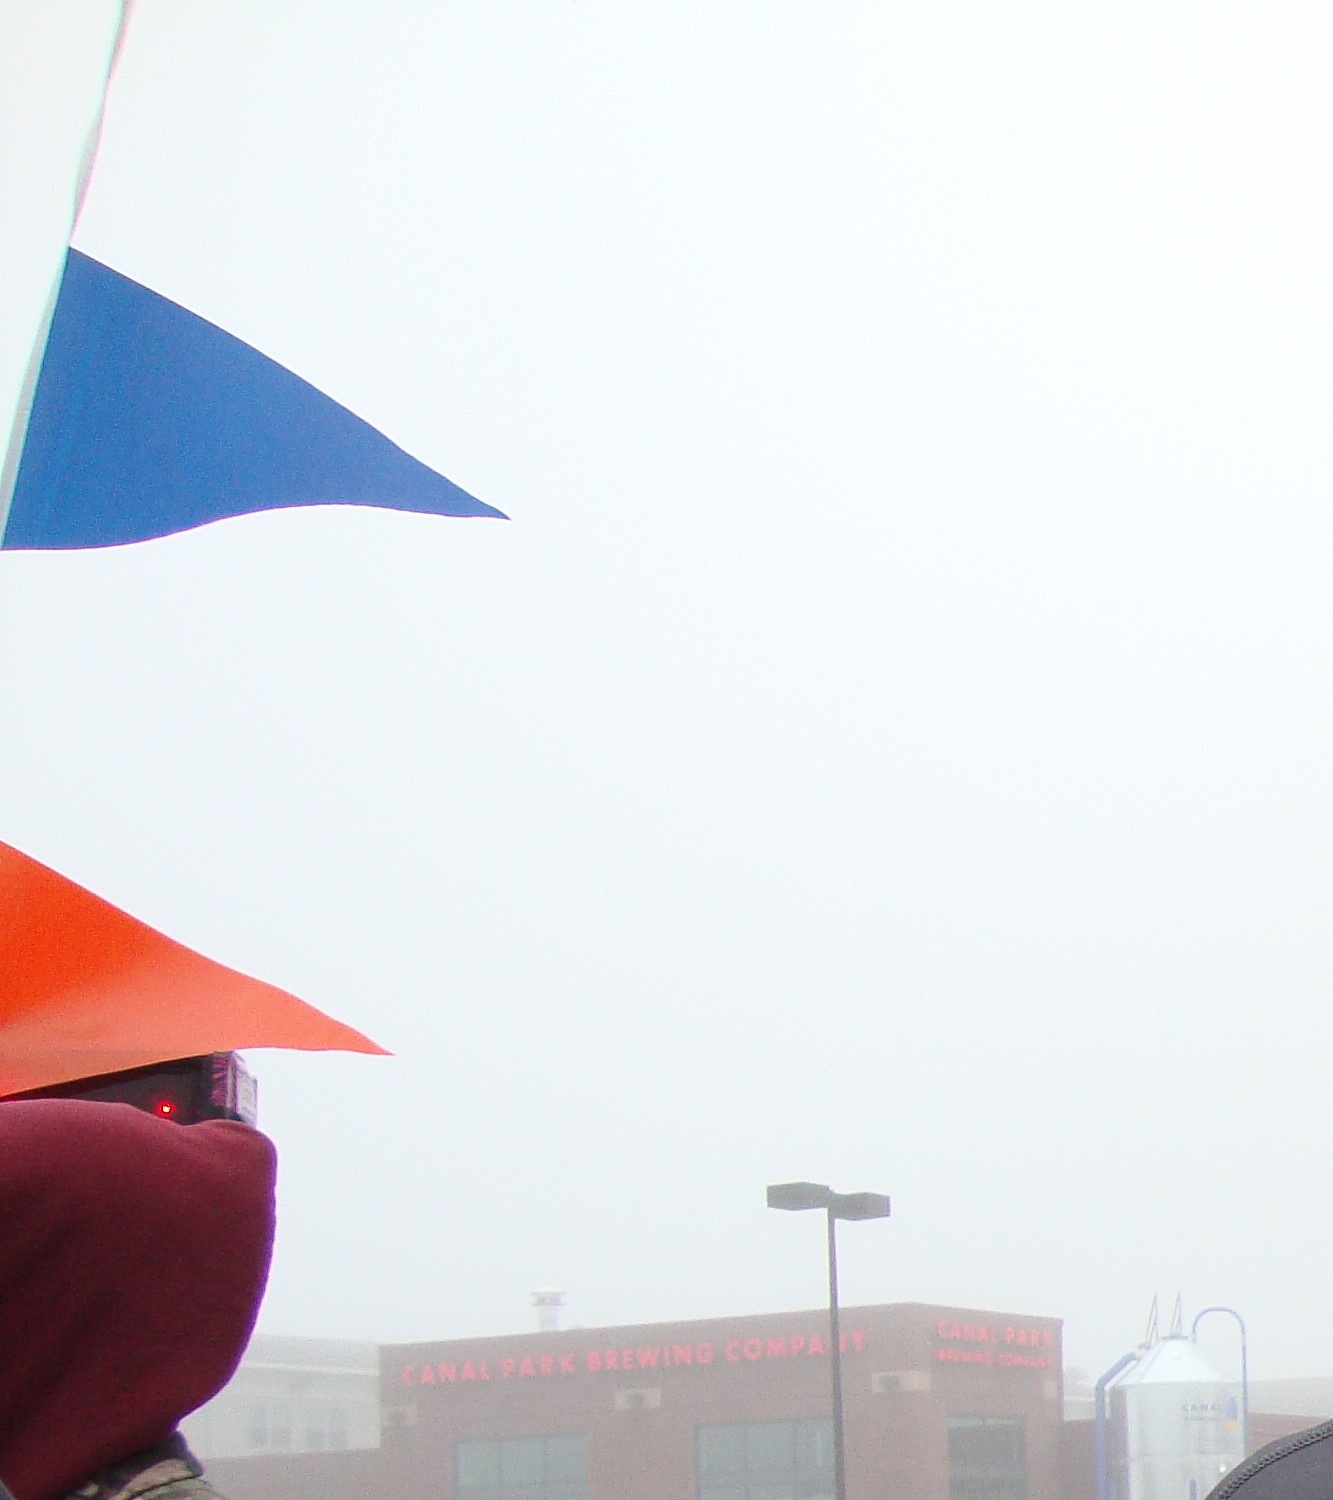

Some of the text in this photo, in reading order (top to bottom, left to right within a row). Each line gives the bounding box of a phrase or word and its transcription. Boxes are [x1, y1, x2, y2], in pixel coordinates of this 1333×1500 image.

[936, 1319, 1052, 1347] CANAL PARK
[402, 1361, 491, 1386] CANAL
[501, 1353, 576, 1377] PARK
[586, 1344, 714, 1373] BREWING
